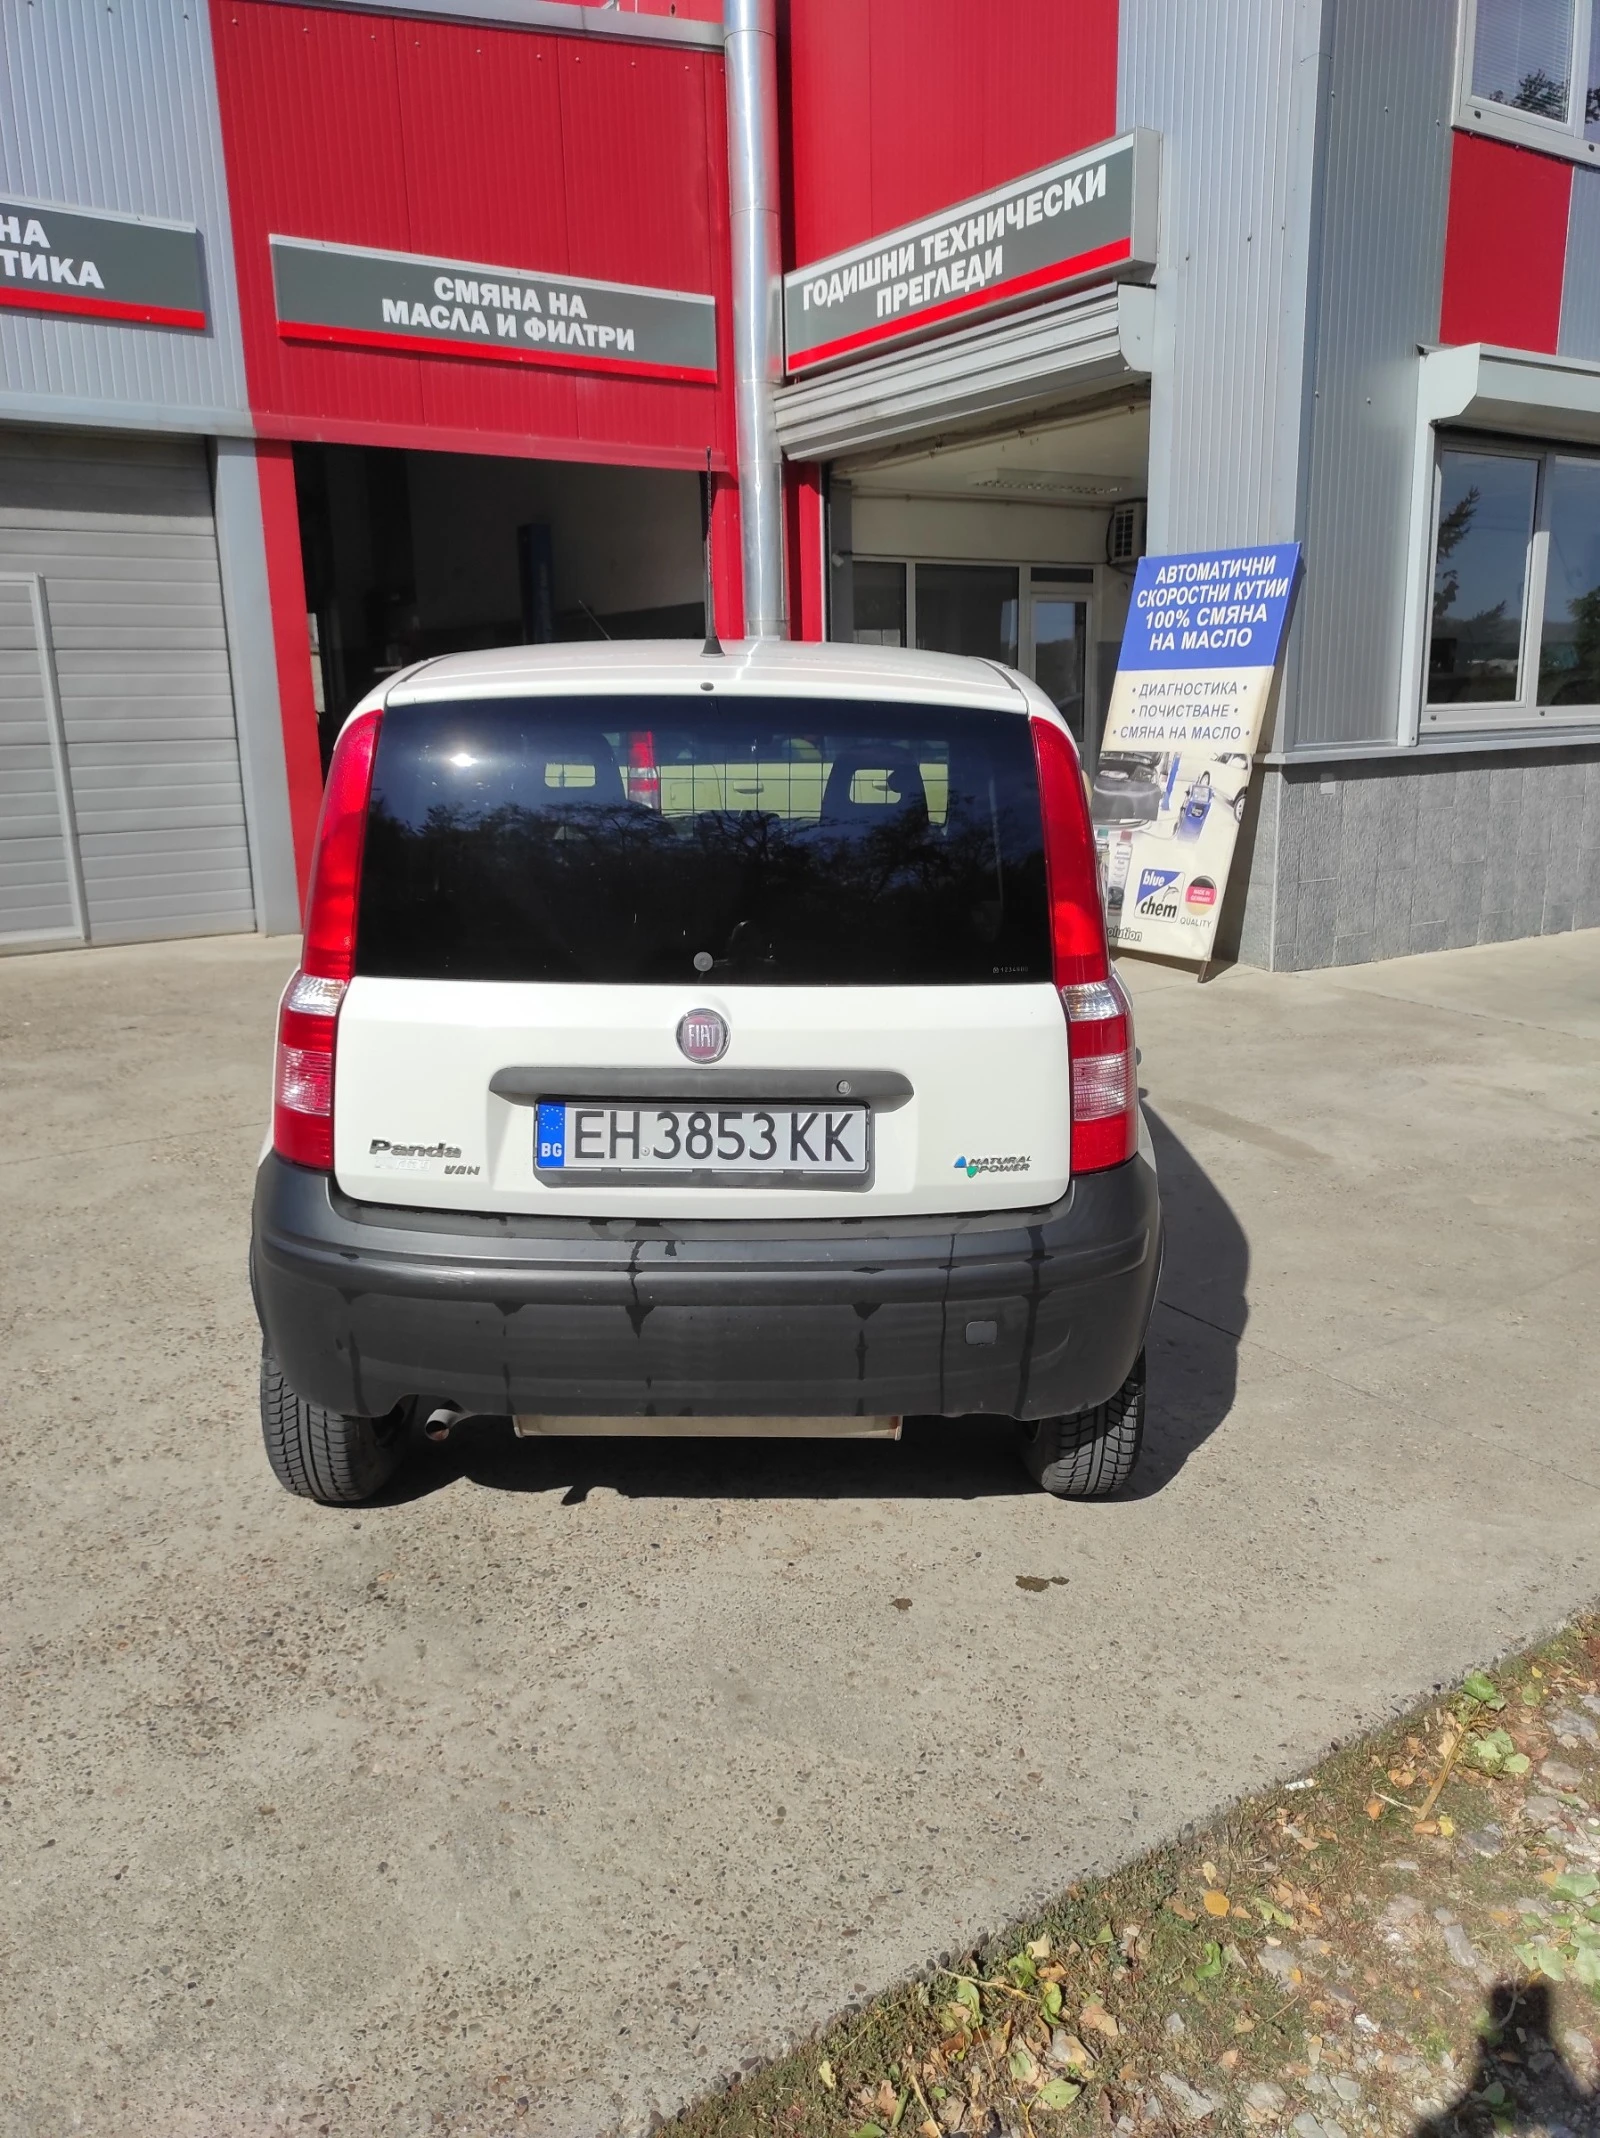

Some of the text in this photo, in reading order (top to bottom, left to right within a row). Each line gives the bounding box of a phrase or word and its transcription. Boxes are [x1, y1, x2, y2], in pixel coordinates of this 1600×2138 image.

[803, 164, 1107, 310] ГОДИШНИ ТЕХНИЧЕСКИ
[876, 245, 1003, 318] ПРЕГЛЕДИ
[434, 276, 588, 319] СМЯНА НА
[382, 298, 636, 351] МАСЛА И ФИЛТРИ
[1155, 554, 1277, 585] АВТОМАТИЧНИ
[1137, 577, 1289, 608] СКОРОСТНИ КУТИИ
[1146, 602, 1268, 630] 100% СМЯНА
[1150, 627, 1253, 651] НА МАСЛО
[1139, 681, 1238, 699] ДИАГНОСТИКА
[1139, 704, 1230, 718] ПОЧИСТВАНЕ
[1120, 726, 1241, 740] СМЯНА НА МАСЛО
[1142, 870, 1166, 887] blue
[1140, 895, 1178, 919] chem
[1180, 916, 1212, 928] QUALITY
[688, 1024, 718, 1048] FIAT
[369, 1138, 462, 1159] Panda
[541, 1142, 563, 1158] BG
[444, 1164, 481, 1176] VAN
[968, 1155, 1032, 1166] NATURAL
[977, 1163, 1031, 1174] POWER
